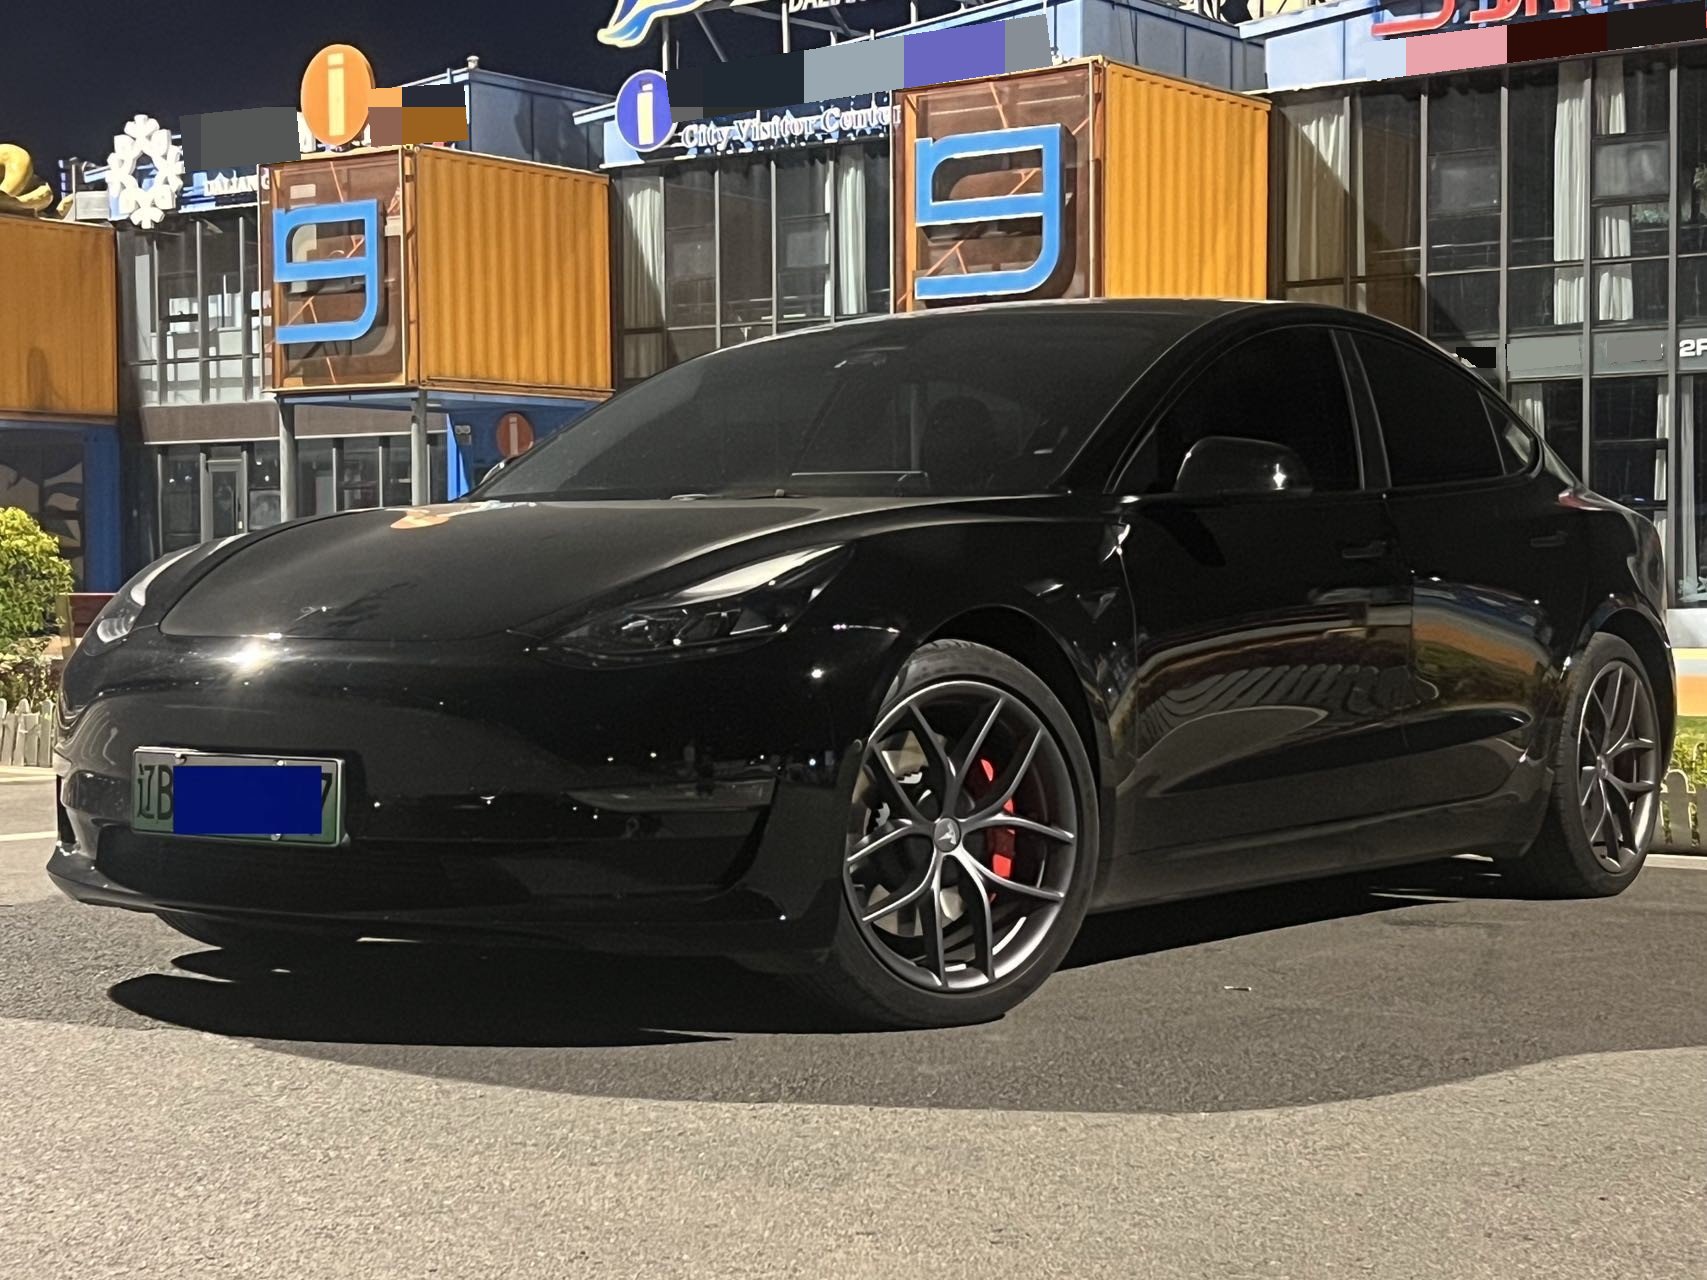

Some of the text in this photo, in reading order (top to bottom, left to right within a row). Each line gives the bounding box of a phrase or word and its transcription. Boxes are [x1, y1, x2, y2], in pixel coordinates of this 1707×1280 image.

[681, 95, 901, 151] City Visitor Center
